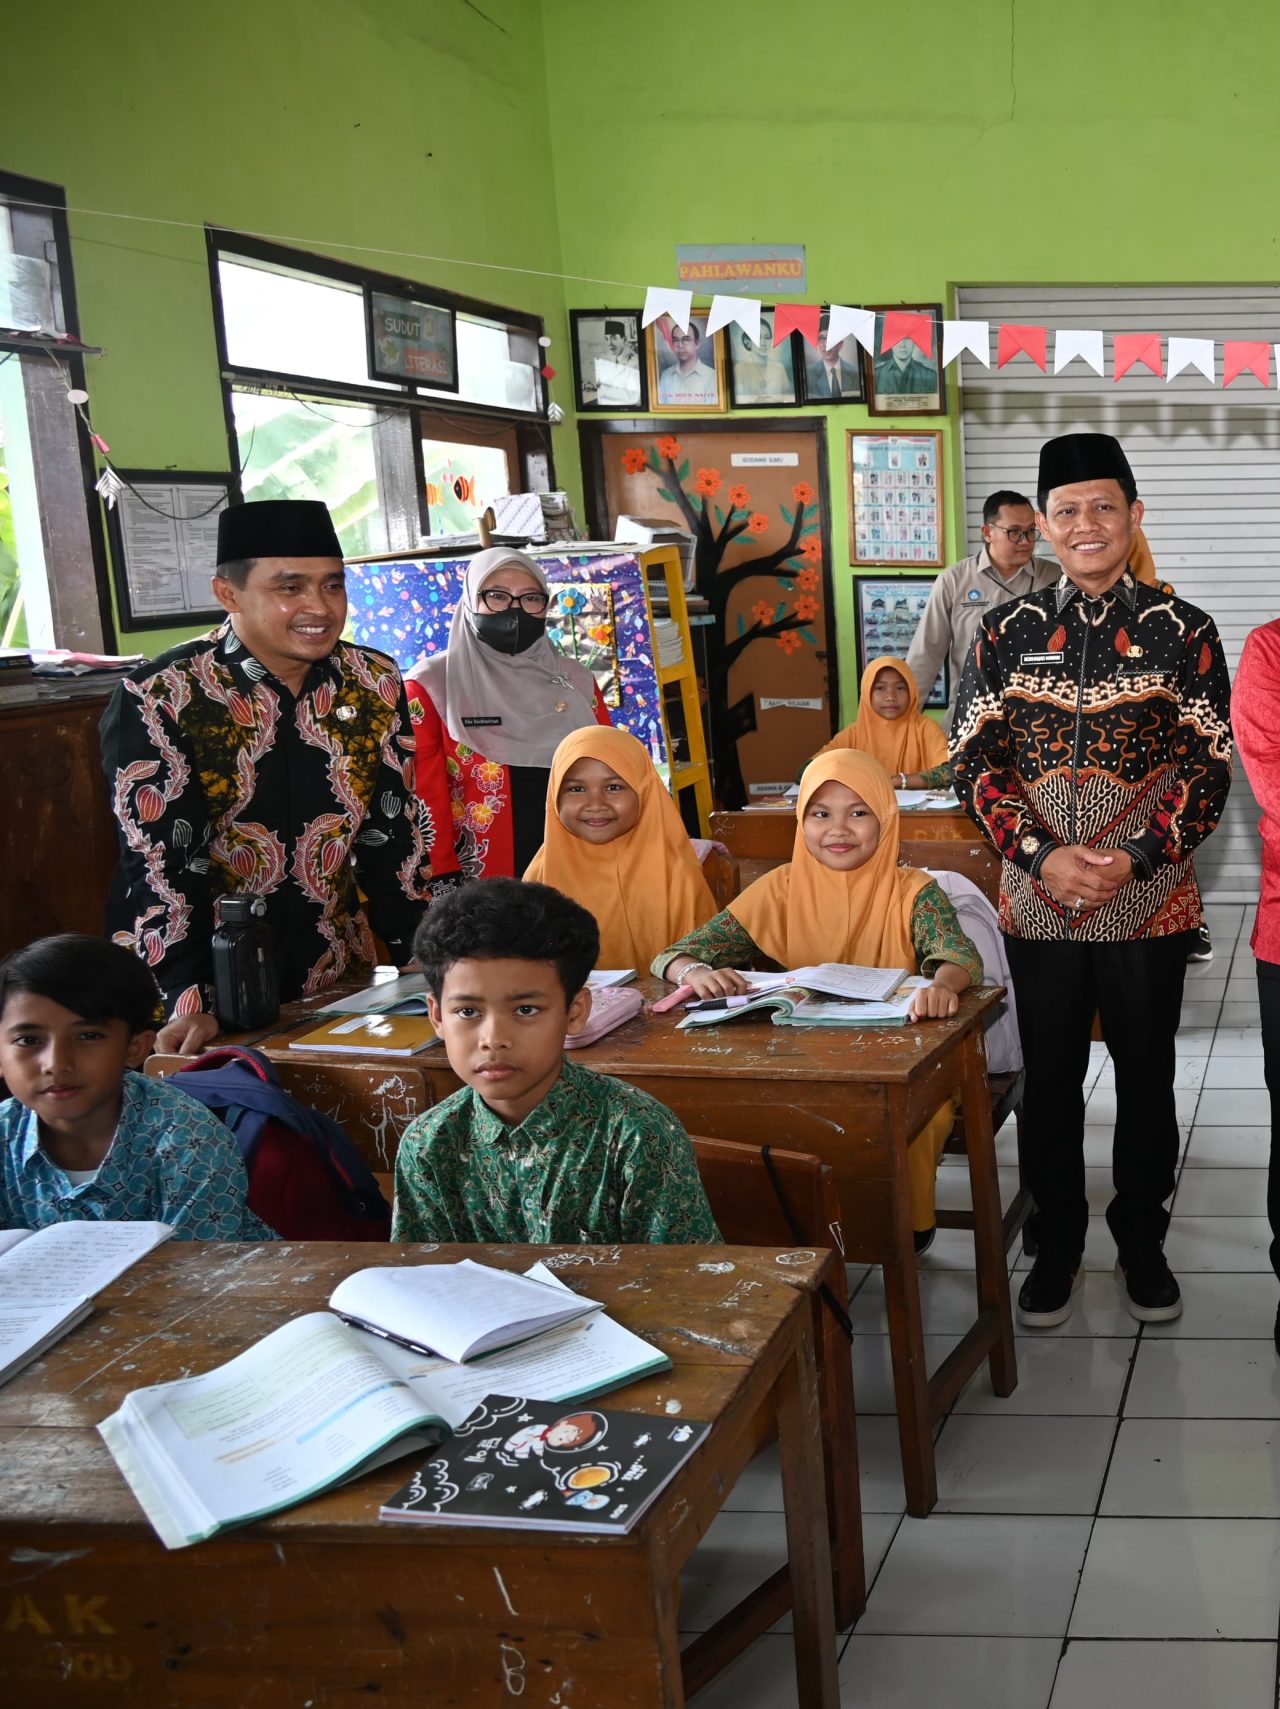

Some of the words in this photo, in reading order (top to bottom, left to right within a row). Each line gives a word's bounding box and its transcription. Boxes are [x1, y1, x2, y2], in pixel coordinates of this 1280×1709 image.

[679, 262, 801, 279] PAHLAWANKU
[384, 317, 420, 337] SUDUT
[404, 353, 448, 371] LITERASI
